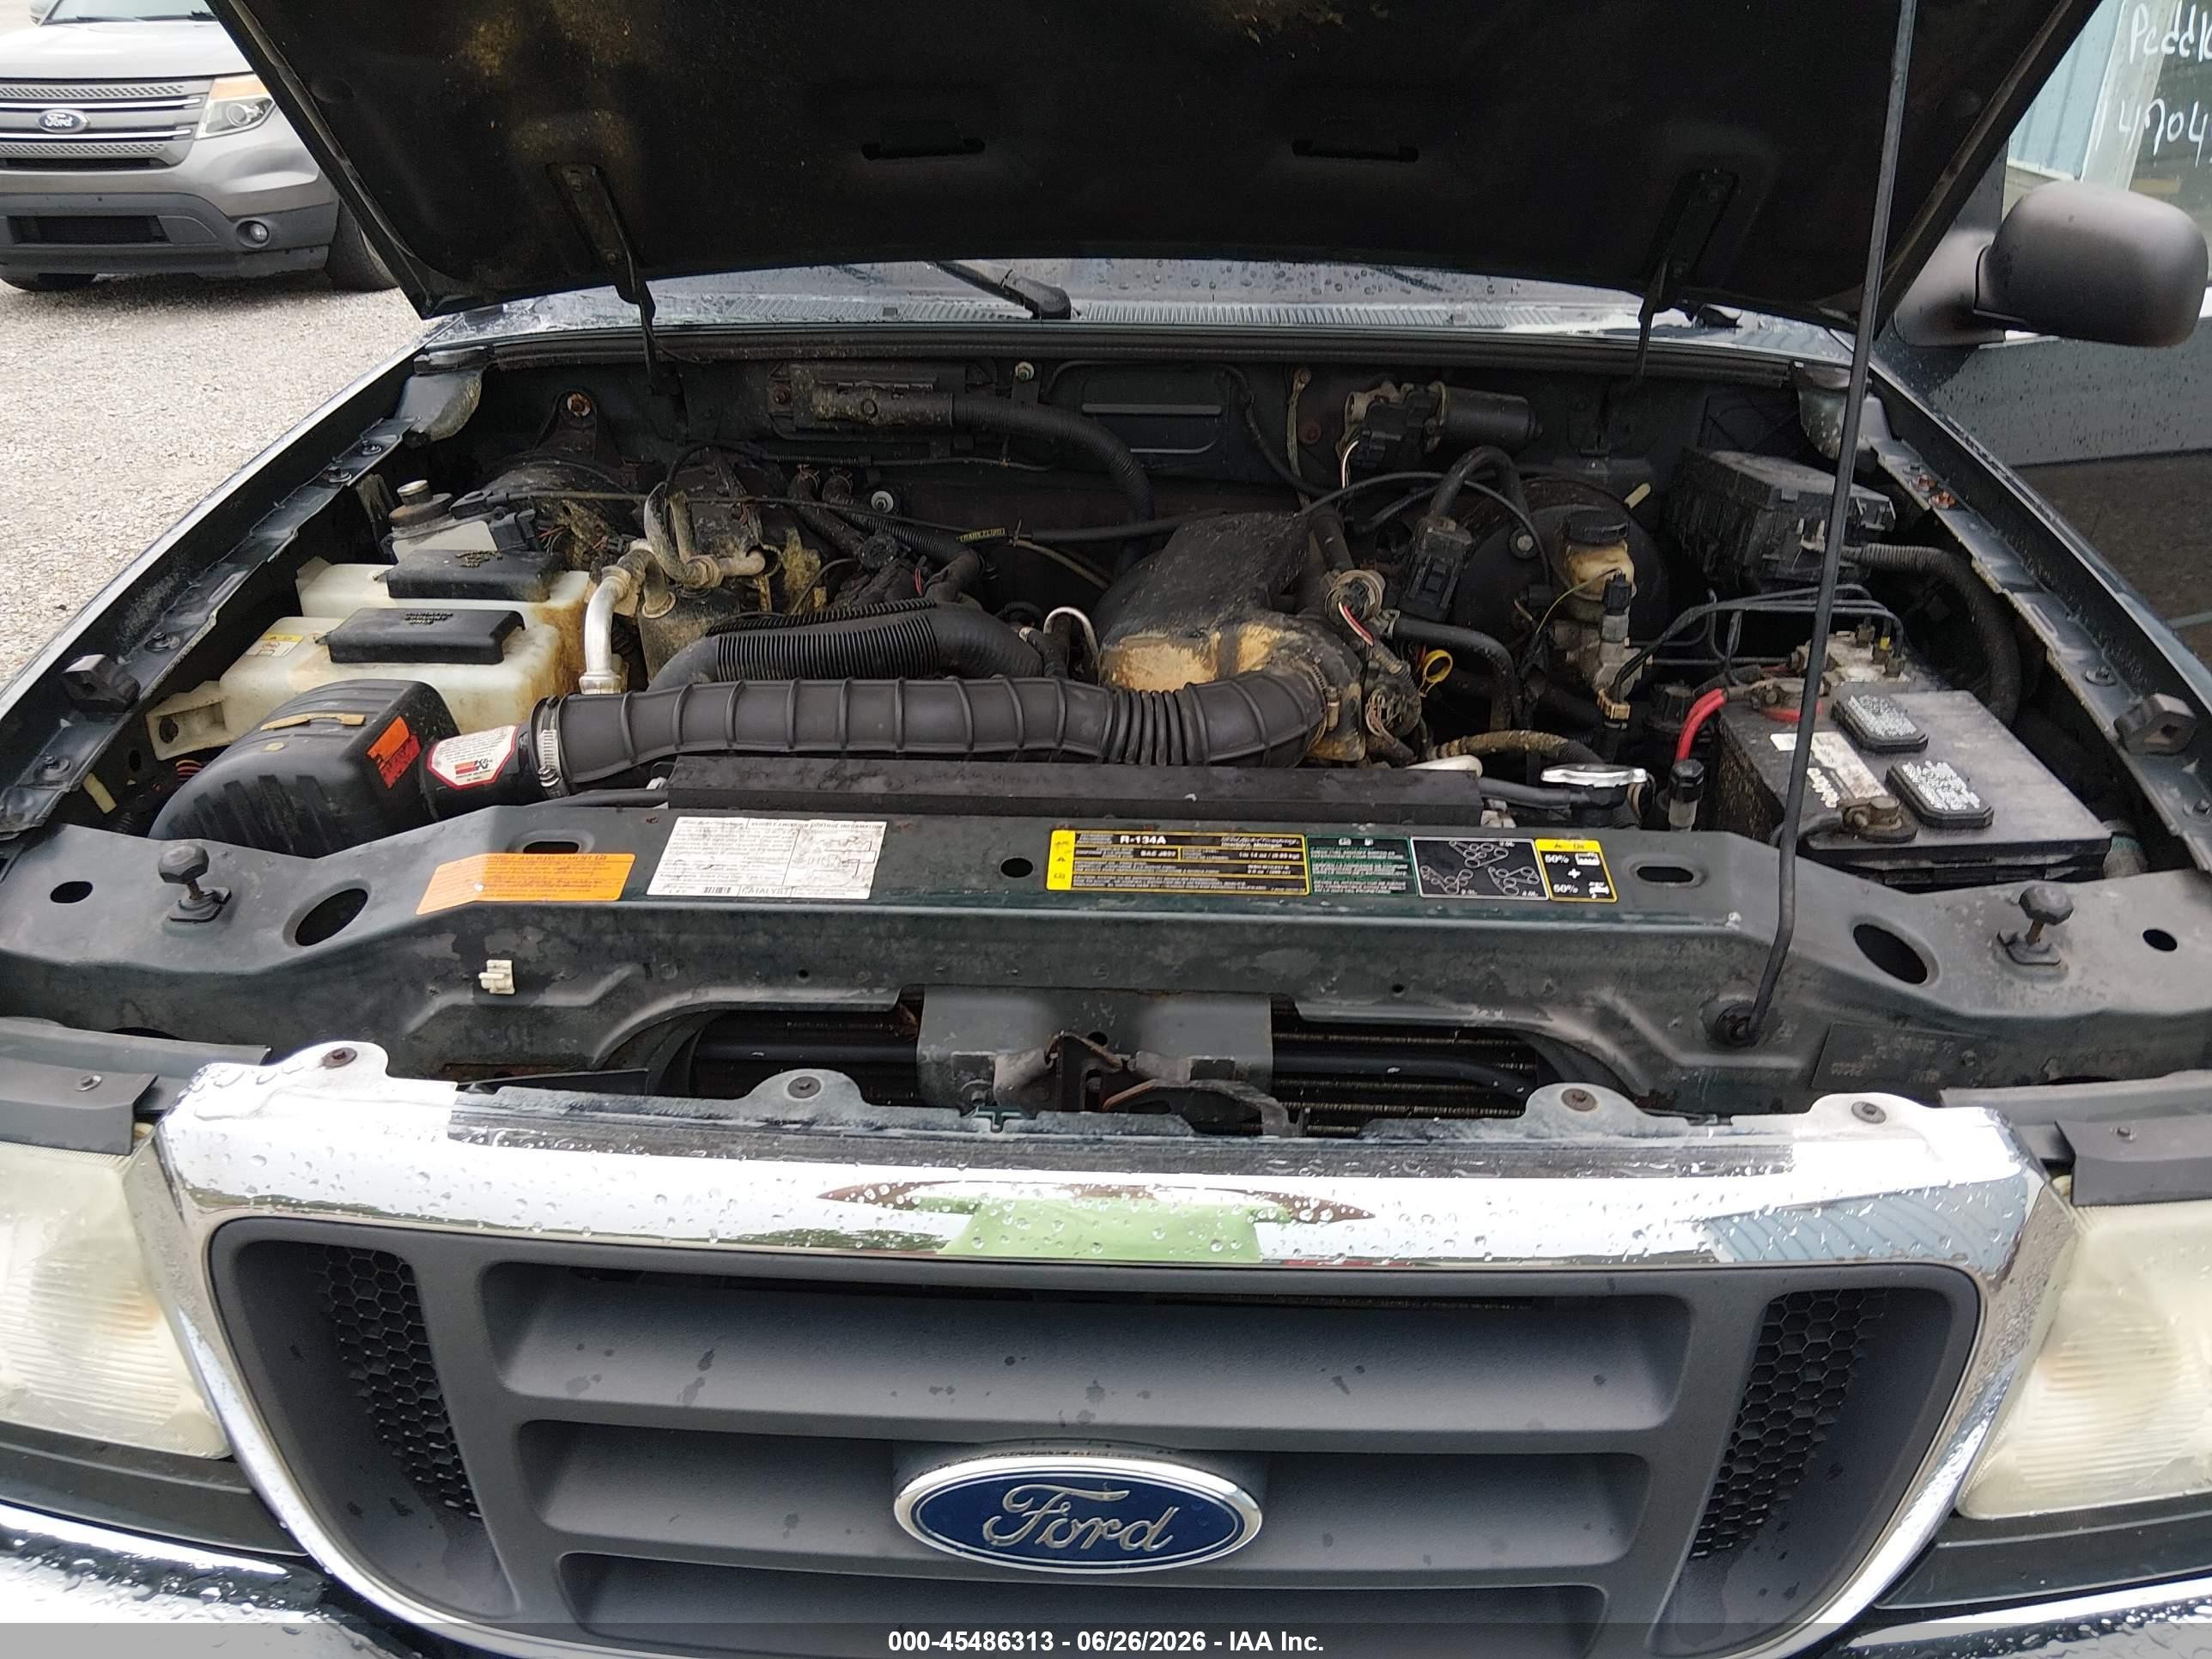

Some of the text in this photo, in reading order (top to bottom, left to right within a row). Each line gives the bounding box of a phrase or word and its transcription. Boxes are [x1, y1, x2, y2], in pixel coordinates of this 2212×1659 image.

[44, 112, 74, 128] Ford
[1120, 835, 1167, 845] R-134A
[981, 1484, 1179, 1553] Ford
